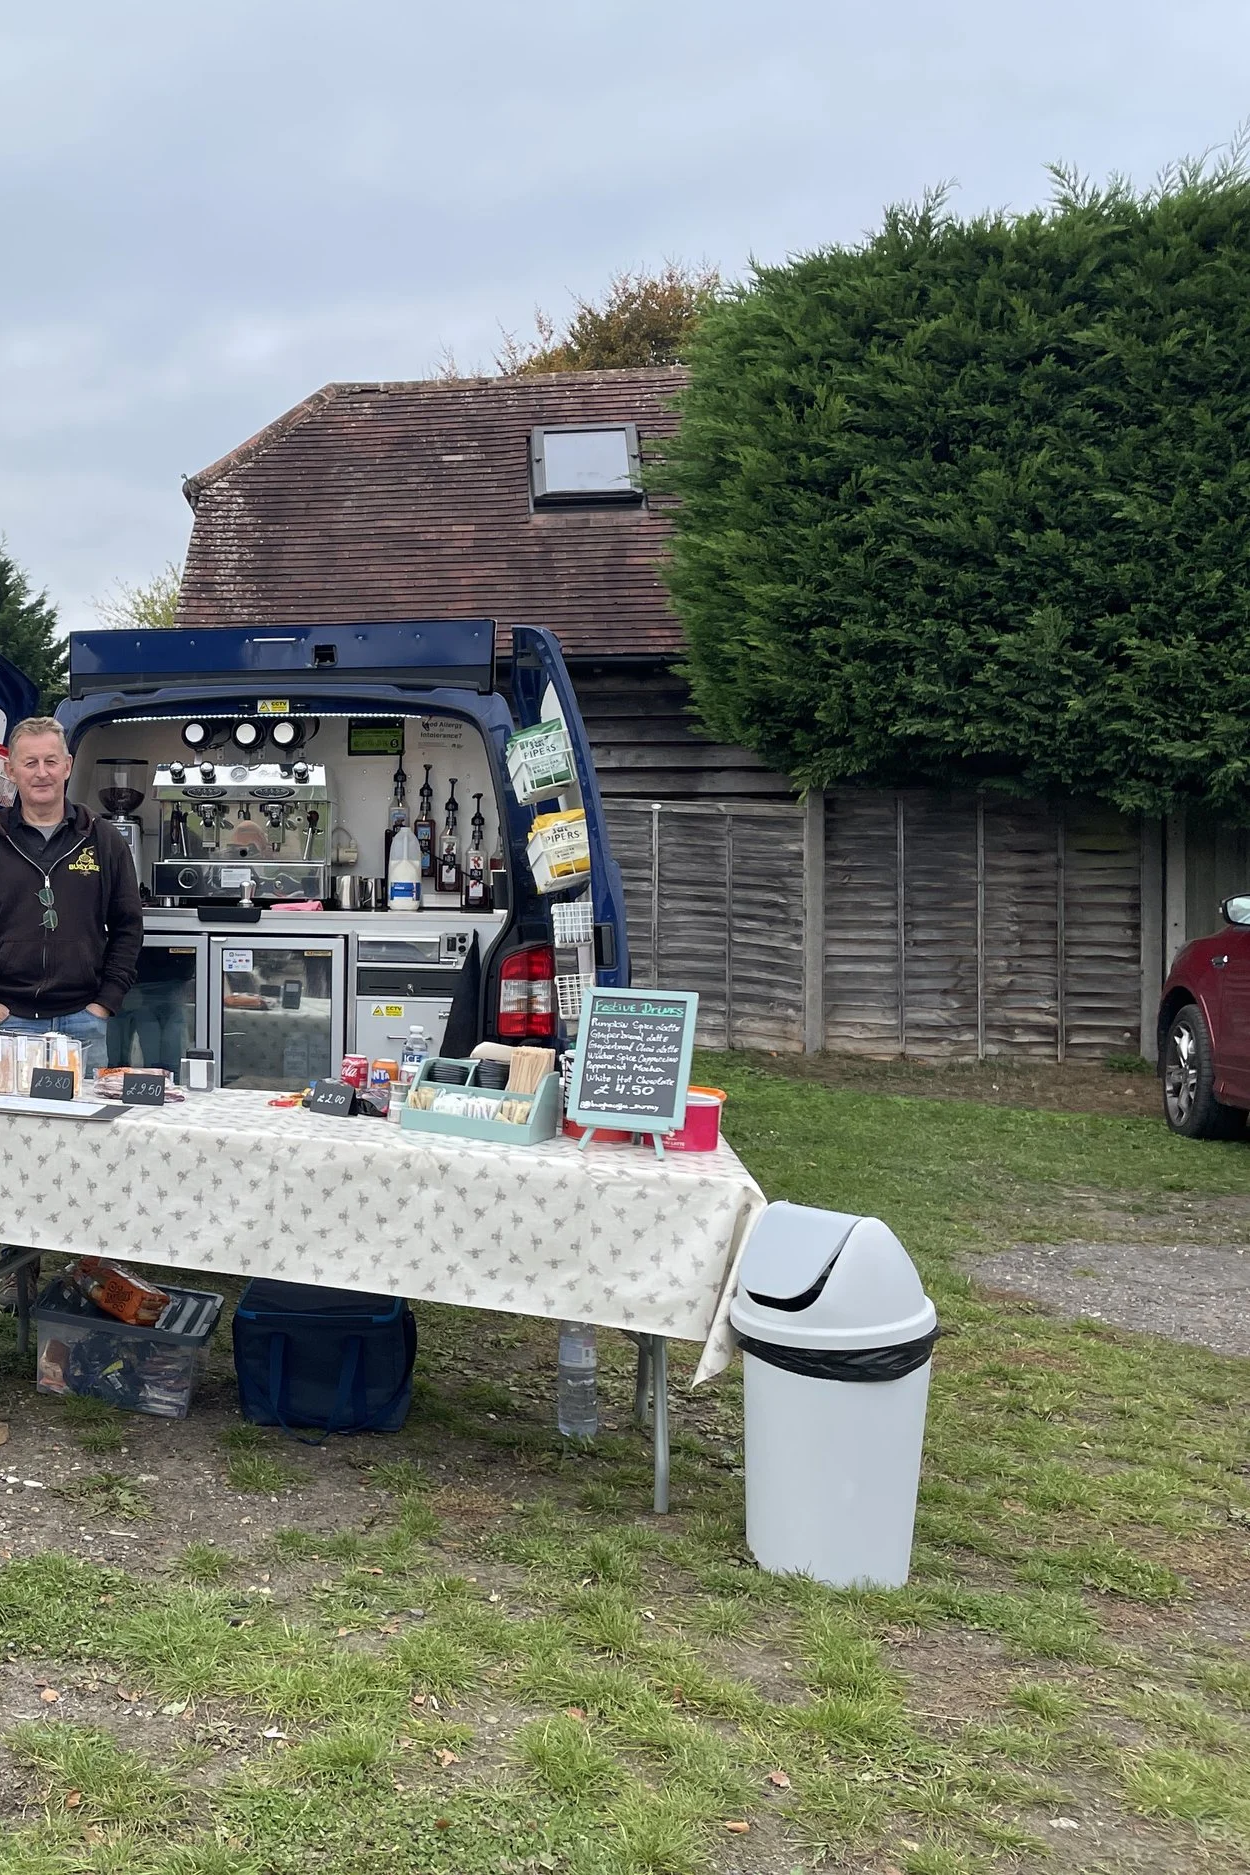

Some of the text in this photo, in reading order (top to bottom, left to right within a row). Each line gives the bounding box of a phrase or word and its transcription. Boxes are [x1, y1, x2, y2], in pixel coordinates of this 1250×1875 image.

[439, 721, 463, 729] Allergy
[523, 744, 557, 760] PIPERS
[546, 830, 580, 845] PIPERS
[404, 1055, 420, 1063] ICE
[617, 1074, 632, 1083] Hot
